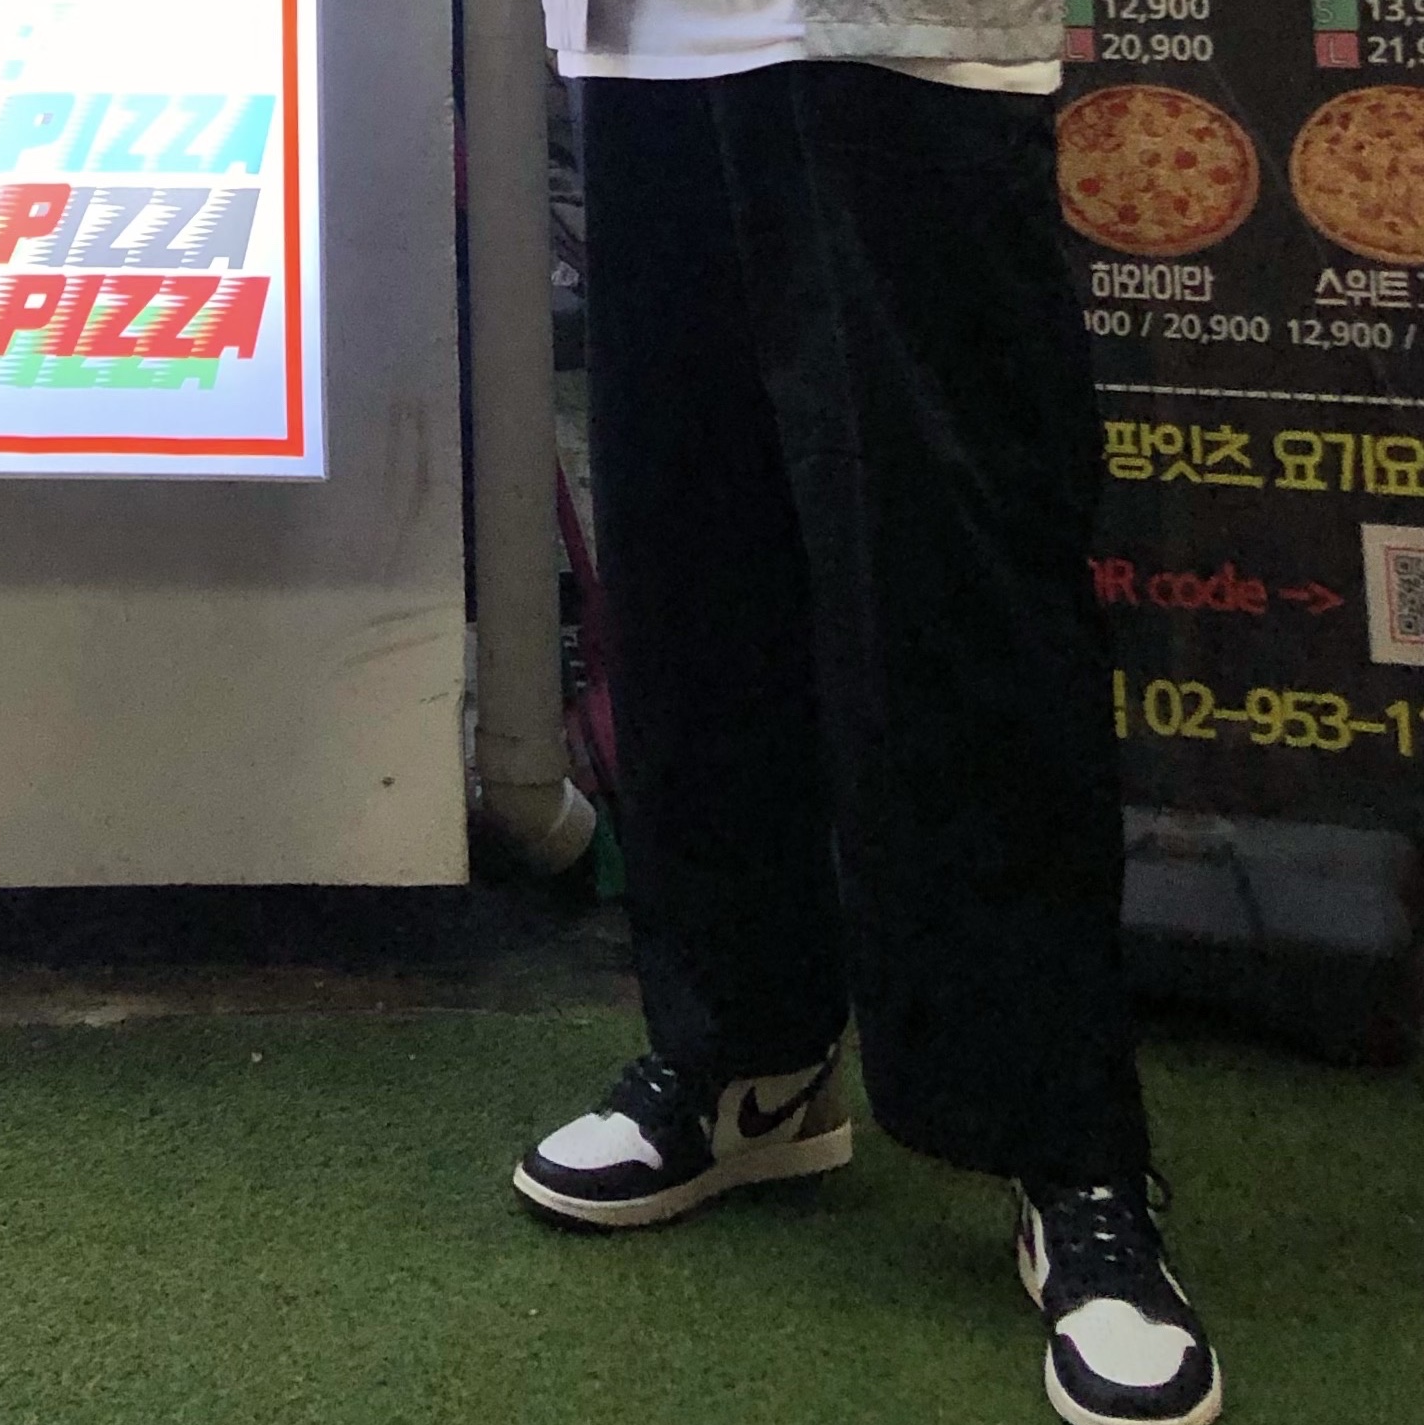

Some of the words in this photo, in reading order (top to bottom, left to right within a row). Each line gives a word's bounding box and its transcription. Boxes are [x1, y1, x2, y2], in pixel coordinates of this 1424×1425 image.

[1101, 33, 1214, 65] 20,900
[26, 186, 263, 270] IZZA
[1090, 262, 1215, 302] 하와이안
[1314, 268, 1412, 307] 스위트
[1163, 313, 1271, 344] 20,900
[1287, 318, 1394, 350] 12,900
[1098, 421, 1265, 489] 팡잇츠
[1273, 430, 1424, 498] 요기요
[1147, 562, 1269, 616] code
[1143, 678, 1424, 758] 02-953-1
